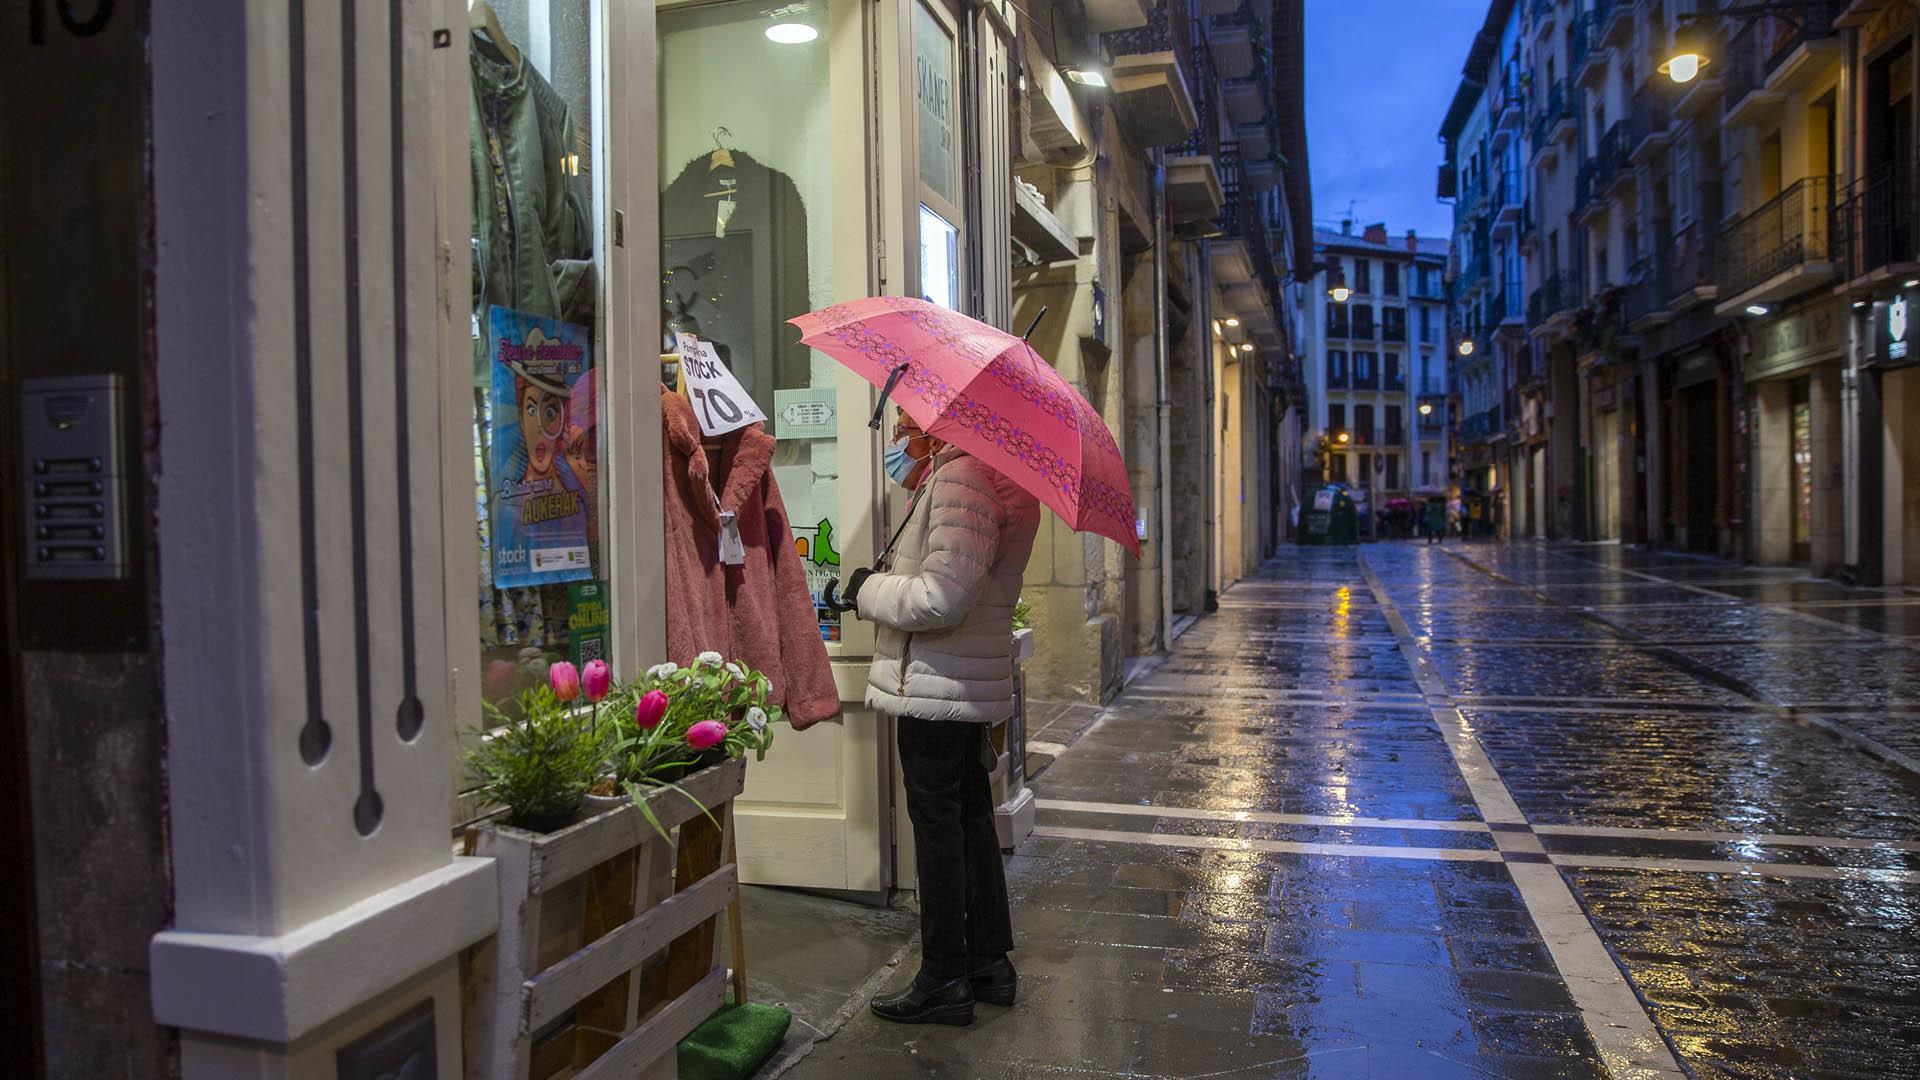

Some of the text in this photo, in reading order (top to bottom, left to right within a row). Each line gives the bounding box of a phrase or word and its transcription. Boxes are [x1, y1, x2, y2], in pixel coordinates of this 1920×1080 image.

[683, 355, 723, 379] STOCK
[693, 387, 744, 430] 70
[523, 491, 580, 525] AUKERAK
[497, 544, 527, 564] stock
